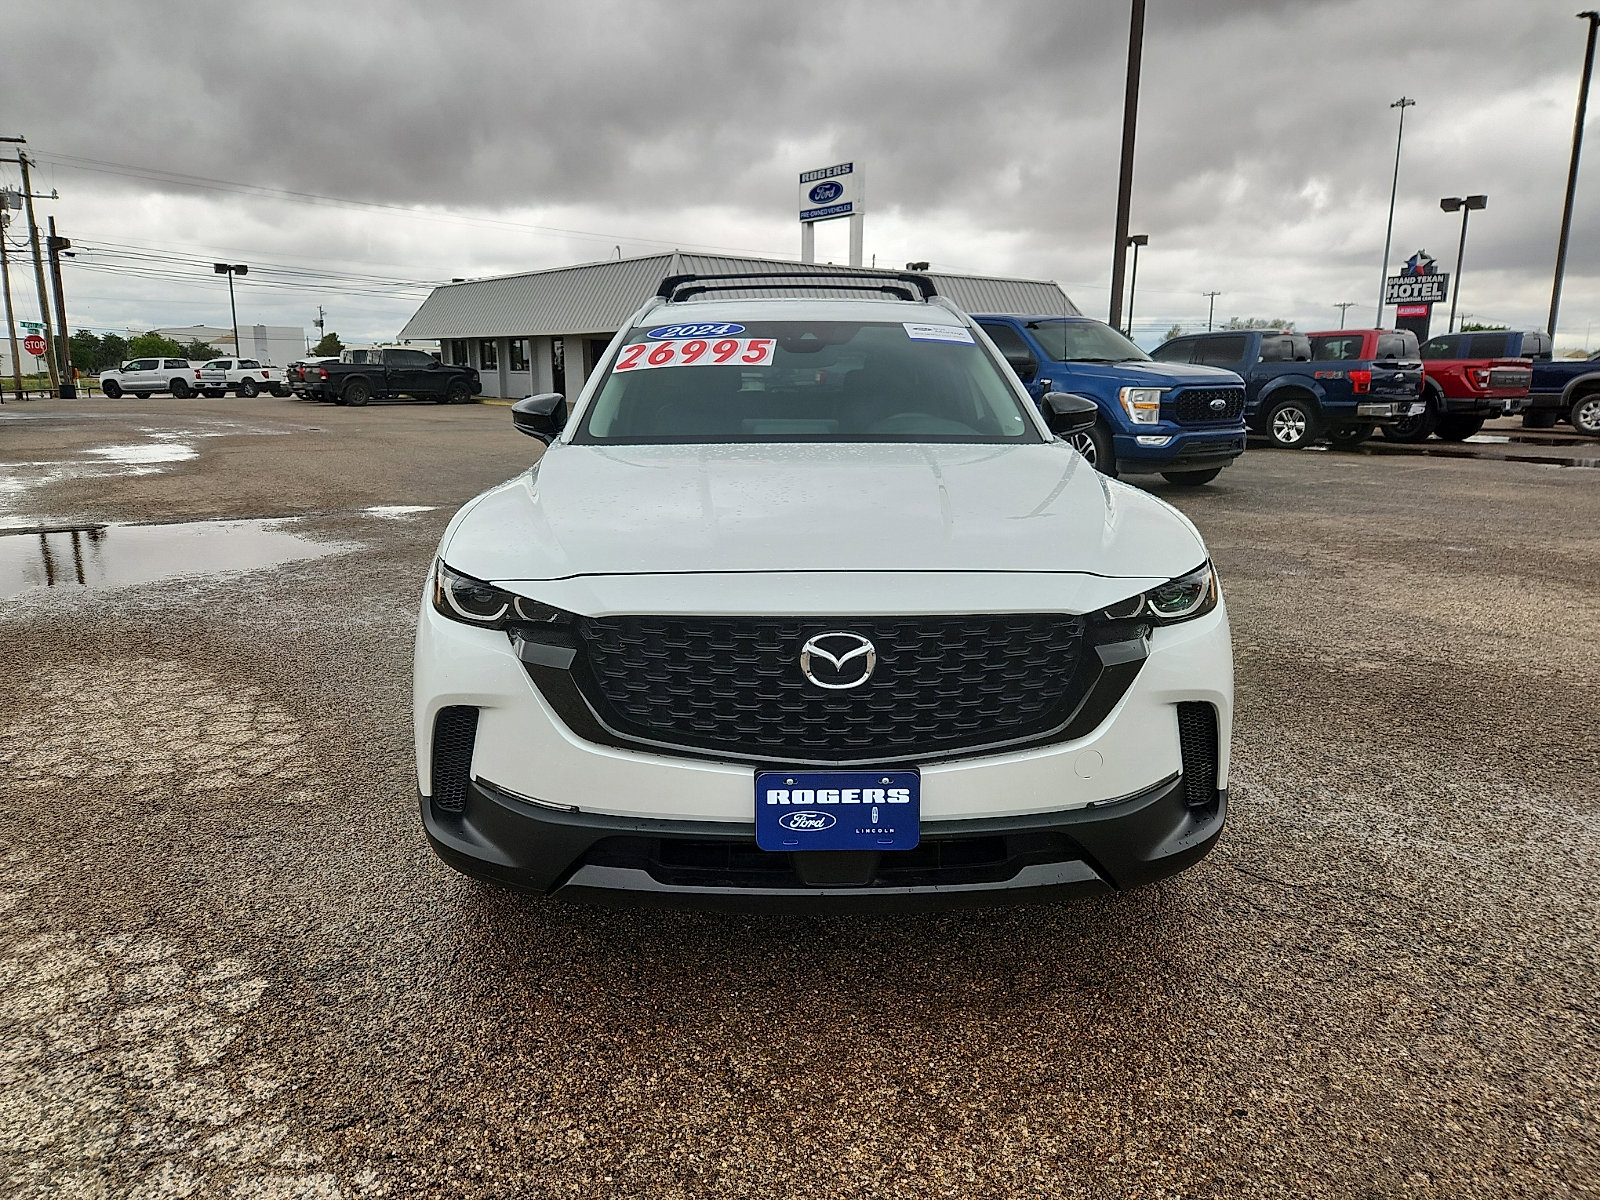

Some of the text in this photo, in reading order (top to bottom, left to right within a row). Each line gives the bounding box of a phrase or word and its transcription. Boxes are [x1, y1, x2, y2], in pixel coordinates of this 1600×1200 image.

[801, 164, 850, 183] ROGERS
[814, 184, 836, 201] Ford
[801, 204, 850, 218] PRE-OWNED VEHICLES
[1388, 275, 1444, 285] GRAND TEXAN
[1386, 283, 1442, 298] HOTEL
[660, 323, 729, 339] 2024
[25, 340, 45, 349] STOP
[615, 339, 773, 371] 26995
[766, 788, 911, 805] ROGERS
[789, 813, 826, 829] Ford
